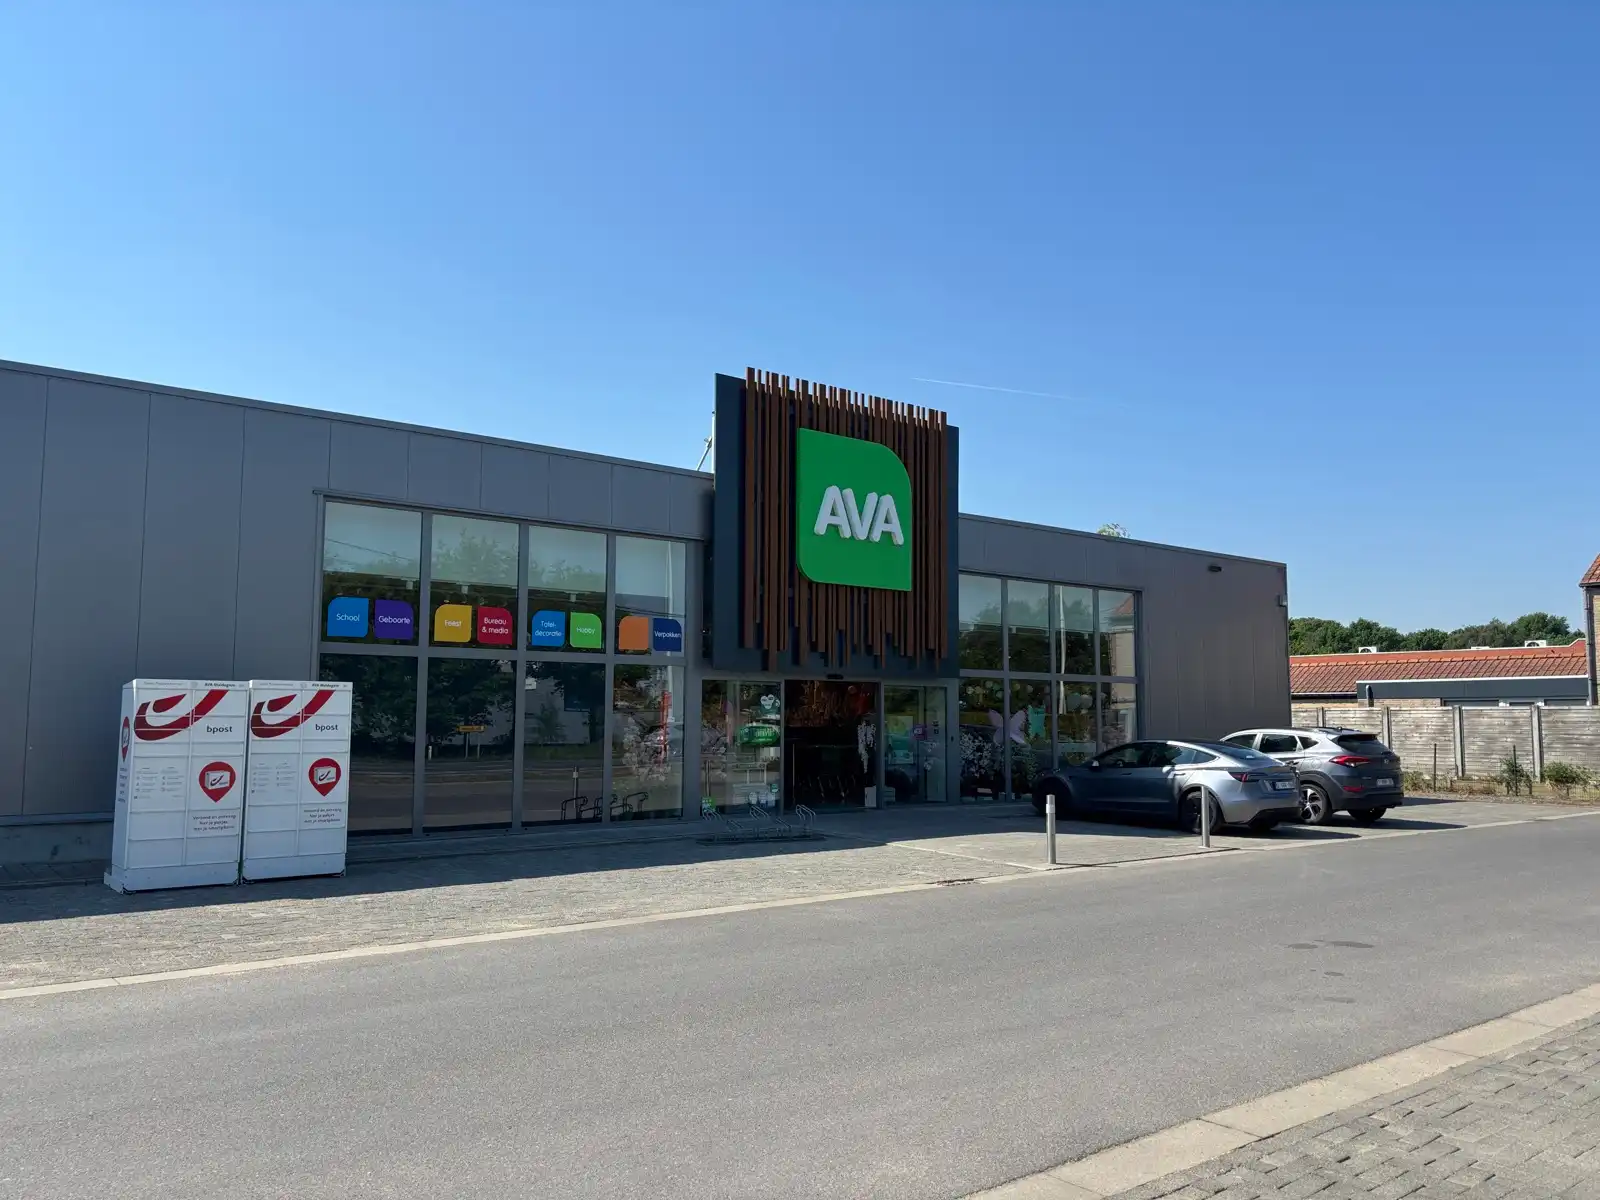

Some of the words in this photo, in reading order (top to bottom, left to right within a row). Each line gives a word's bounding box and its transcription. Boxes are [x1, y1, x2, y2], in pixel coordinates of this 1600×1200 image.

[814, 485, 905, 546] AVA
[336, 613, 360, 622] School
[378, 615, 411, 625] Geboorte
[484, 617, 507, 625] Bureau
[444, 619, 462, 628] Feest
[540, 620, 557, 628] Tafel-
[489, 626, 509, 634] media
[534, 629, 562, 637] decoratie
[576, 627, 595, 635] Hobby
[654, 630, 682, 639] Verpakken
[206, 725, 233, 734] bpost
[315, 724, 339, 732] bpost
